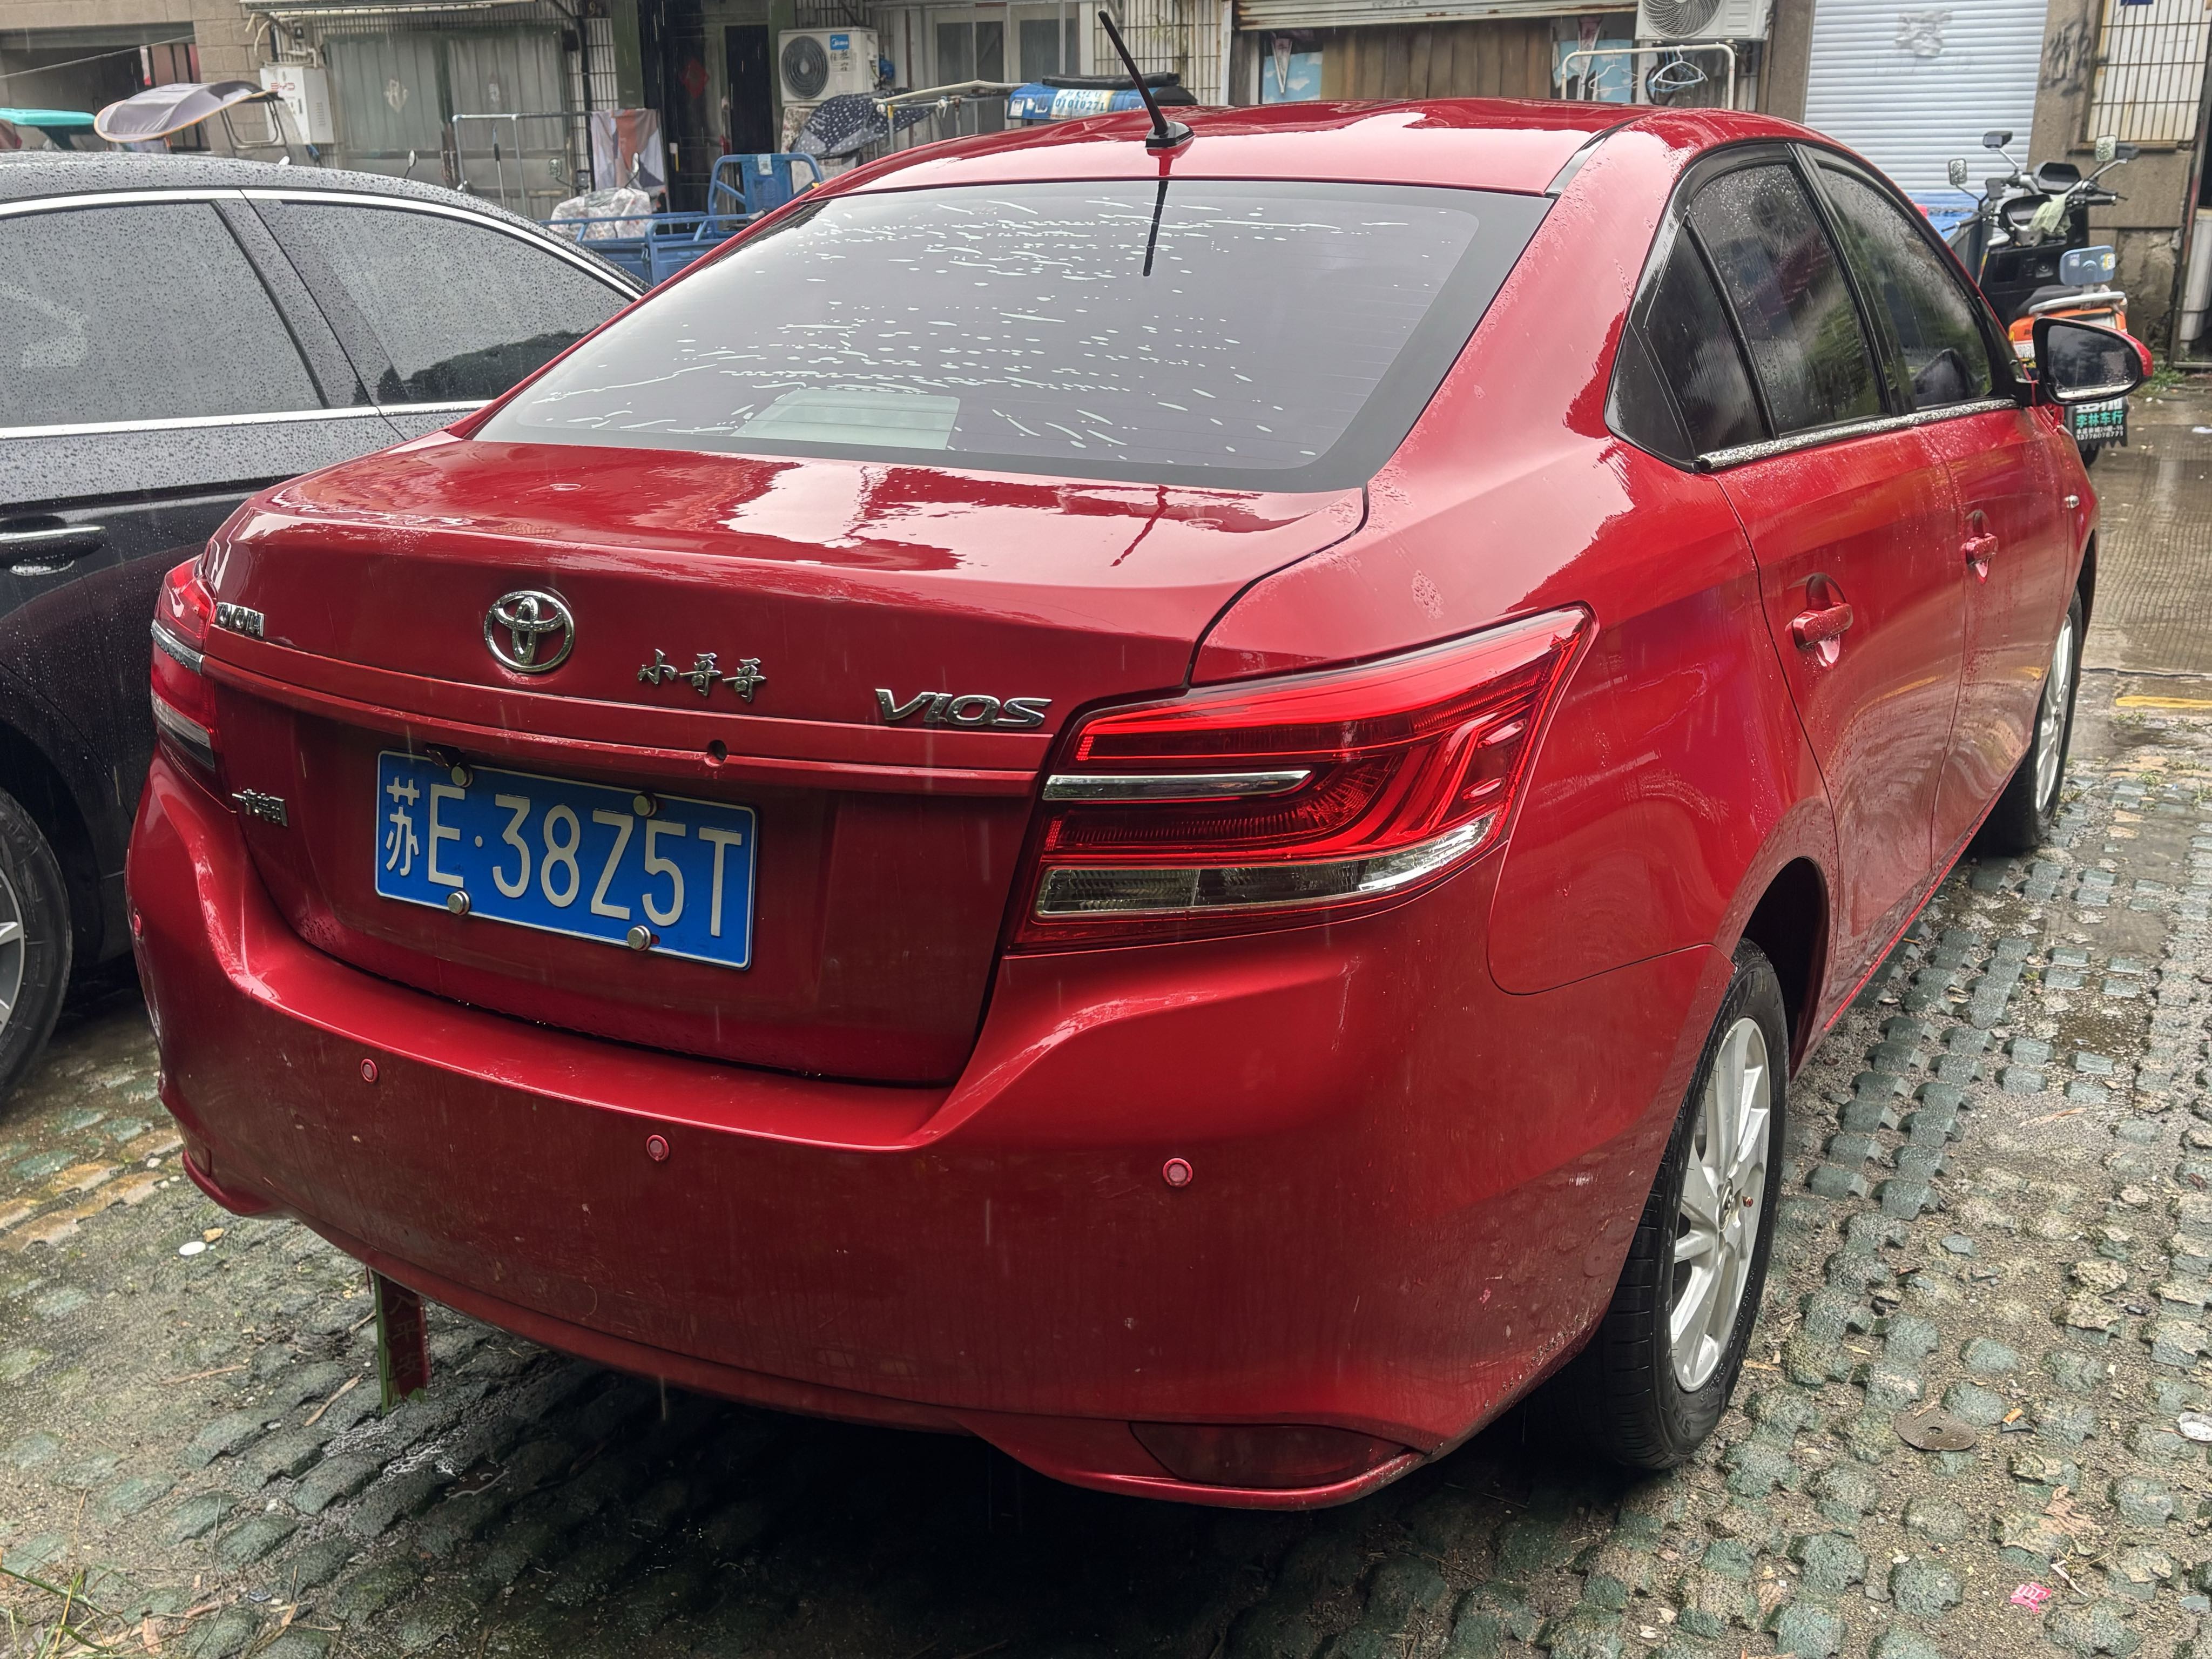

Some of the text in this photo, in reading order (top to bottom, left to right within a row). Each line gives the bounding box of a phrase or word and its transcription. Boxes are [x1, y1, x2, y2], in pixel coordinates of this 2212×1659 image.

[637, 648, 767, 703] 小哥哥
[875, 689, 1053, 727] VIOS
[386, 776, 743, 937] 苏E·38Z5T
